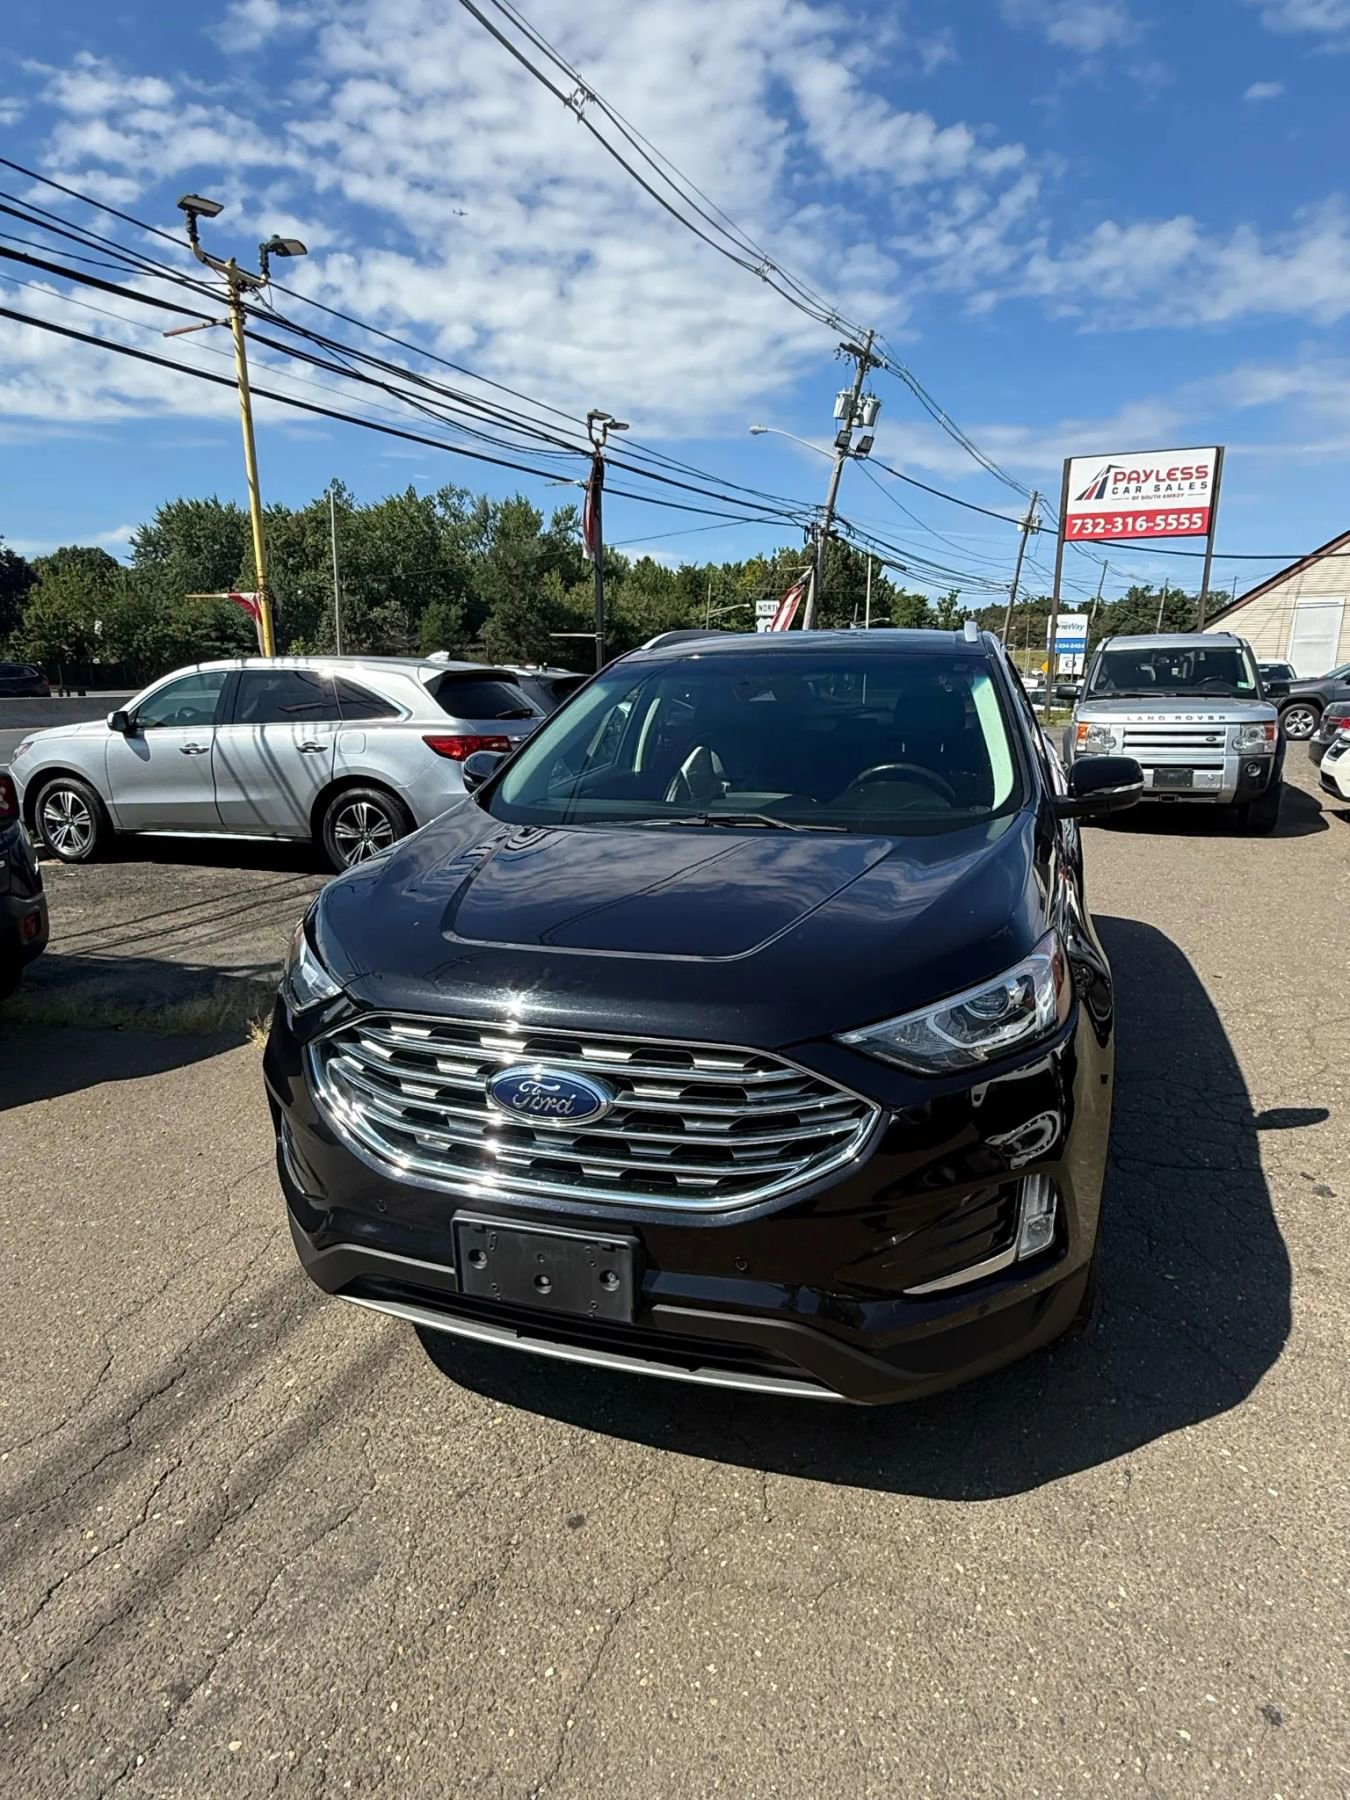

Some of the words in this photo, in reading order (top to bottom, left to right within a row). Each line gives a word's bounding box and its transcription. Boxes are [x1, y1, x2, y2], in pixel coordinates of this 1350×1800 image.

[1112, 464, 1209, 485] PAYLESS
[1111, 485, 1143, 495] CAR
[1153, 480, 1208, 492] SALES
[1071, 512, 1203, 535] 732-316-5555
[512, 1080, 577, 1115] Ford
